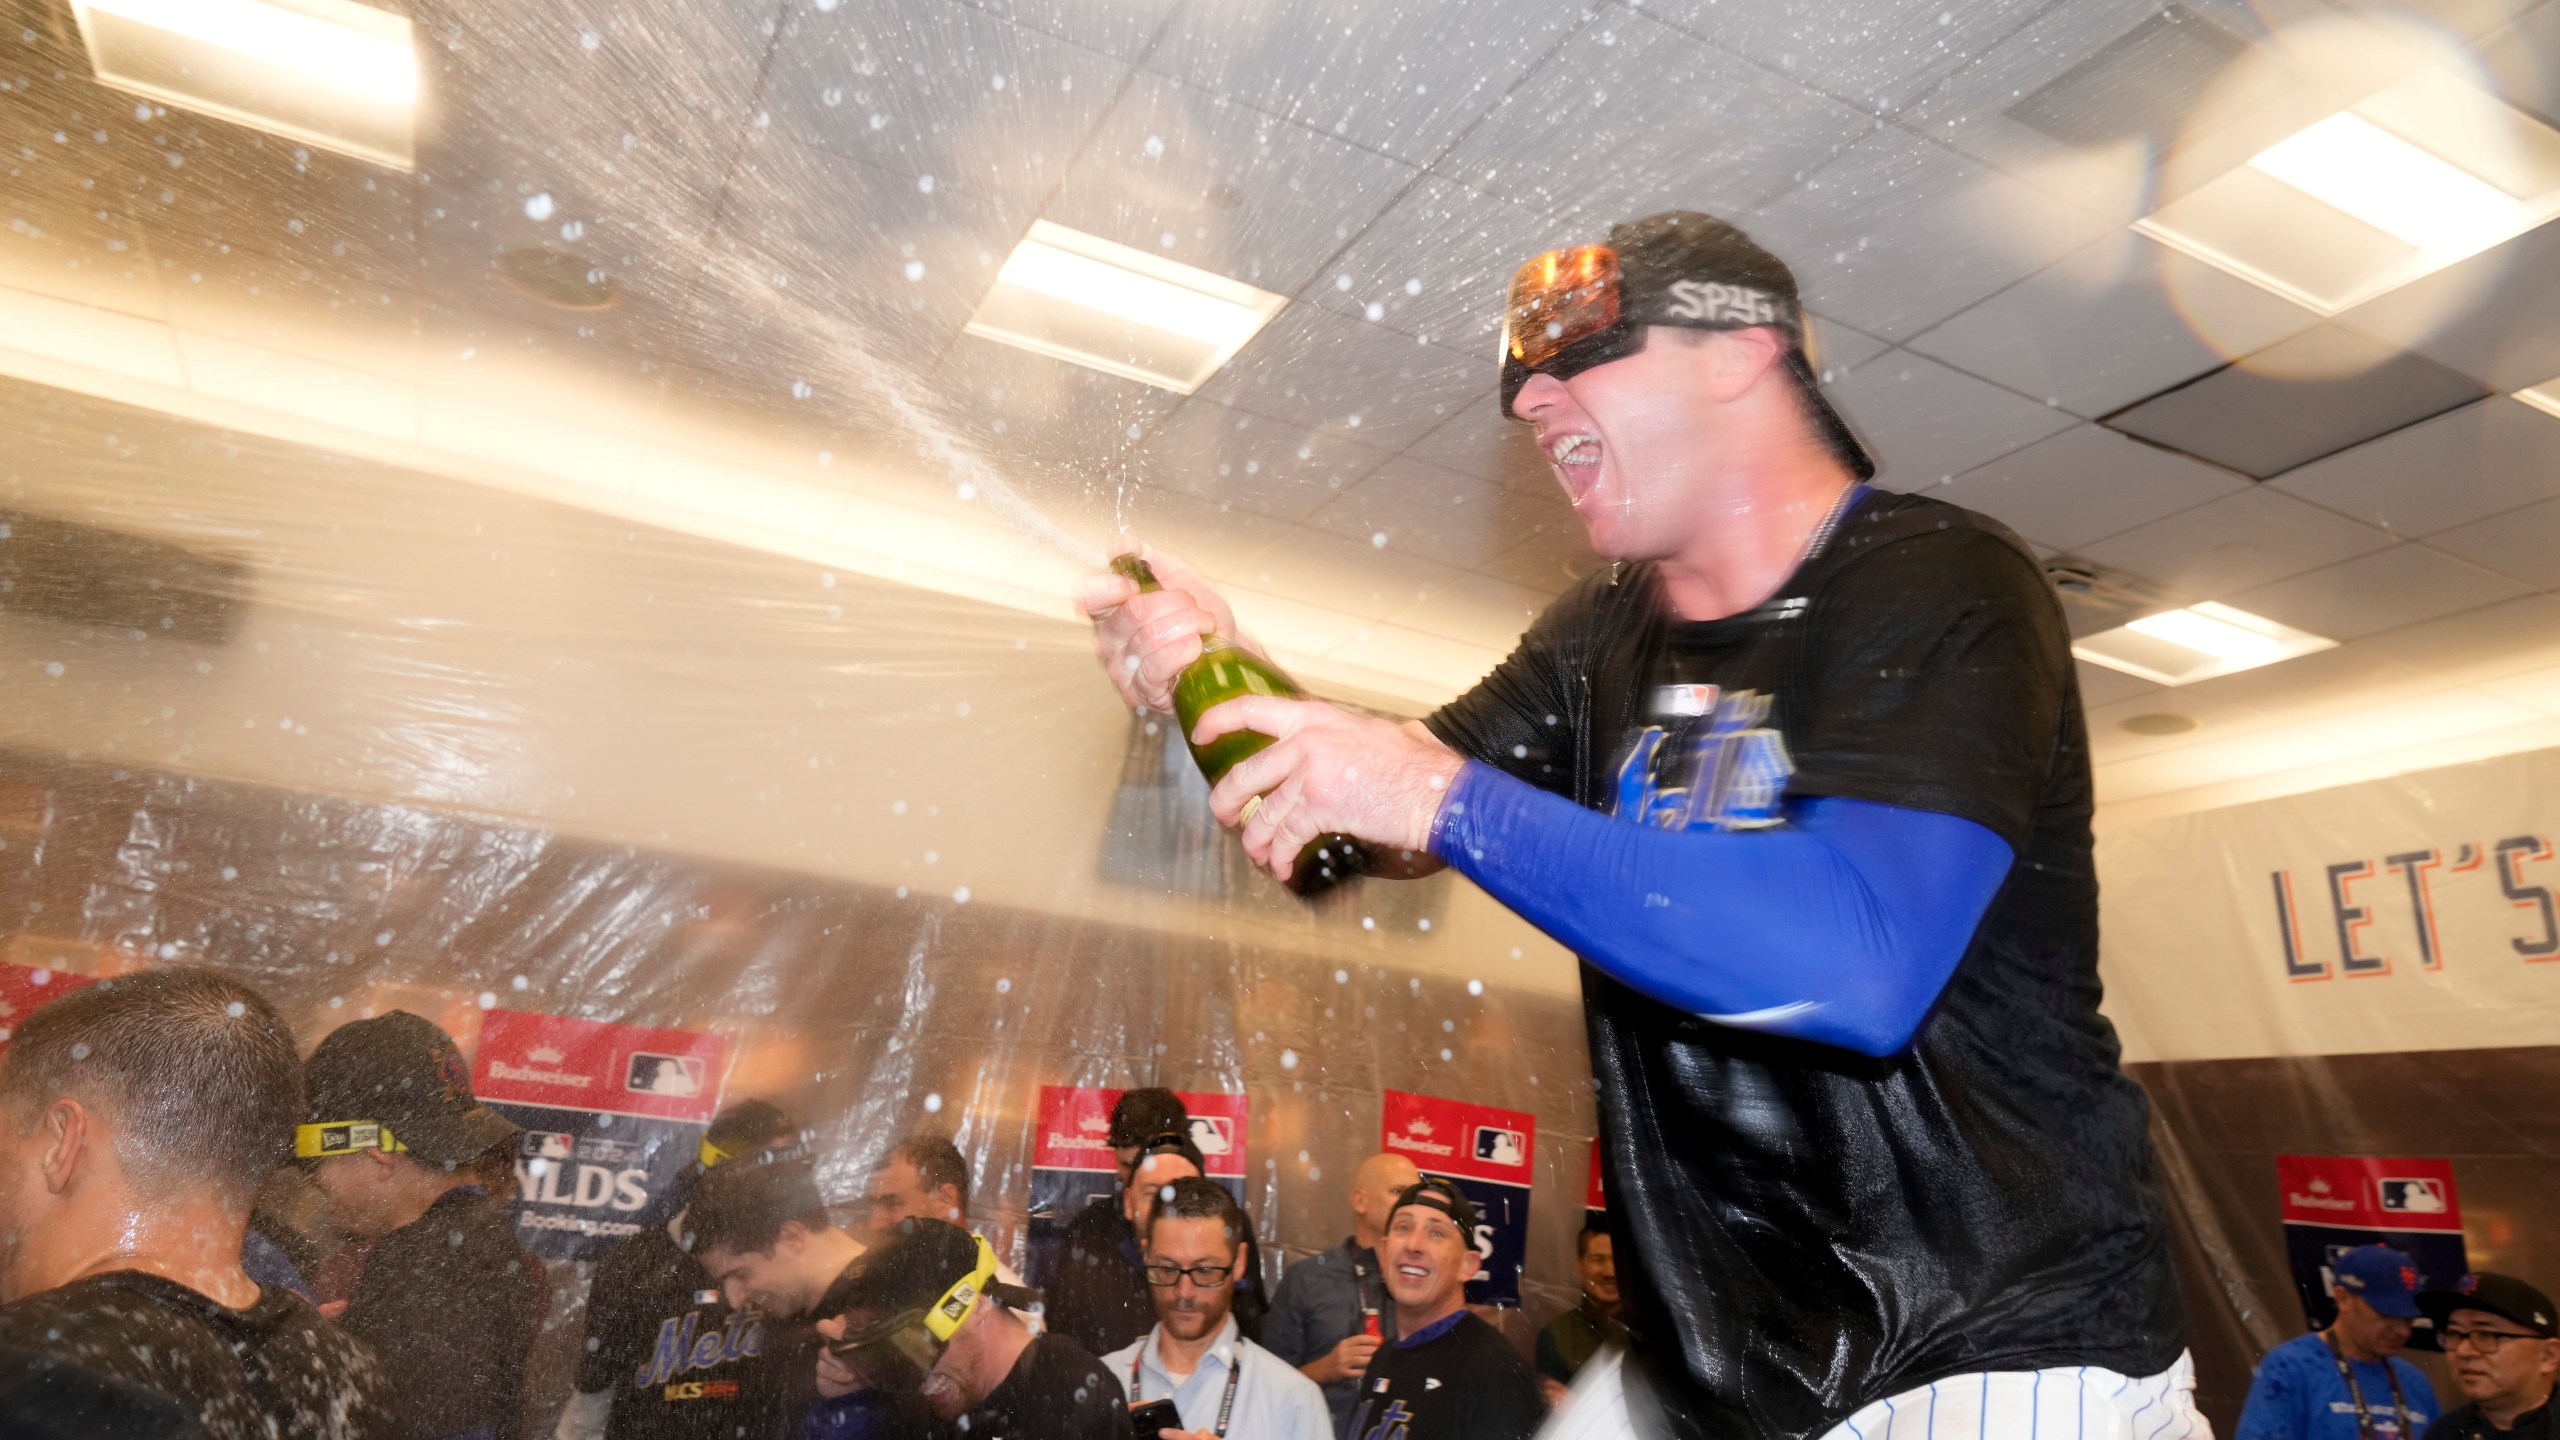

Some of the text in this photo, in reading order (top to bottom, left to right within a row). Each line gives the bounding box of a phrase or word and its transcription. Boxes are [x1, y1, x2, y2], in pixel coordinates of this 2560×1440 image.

[489, 1060, 593, 1088] Budweiser
[577, 1147, 642, 1163] 2024
[1386, 1131, 1454, 1156] Budweiser
[520, 1210, 642, 1238] Booking.com
